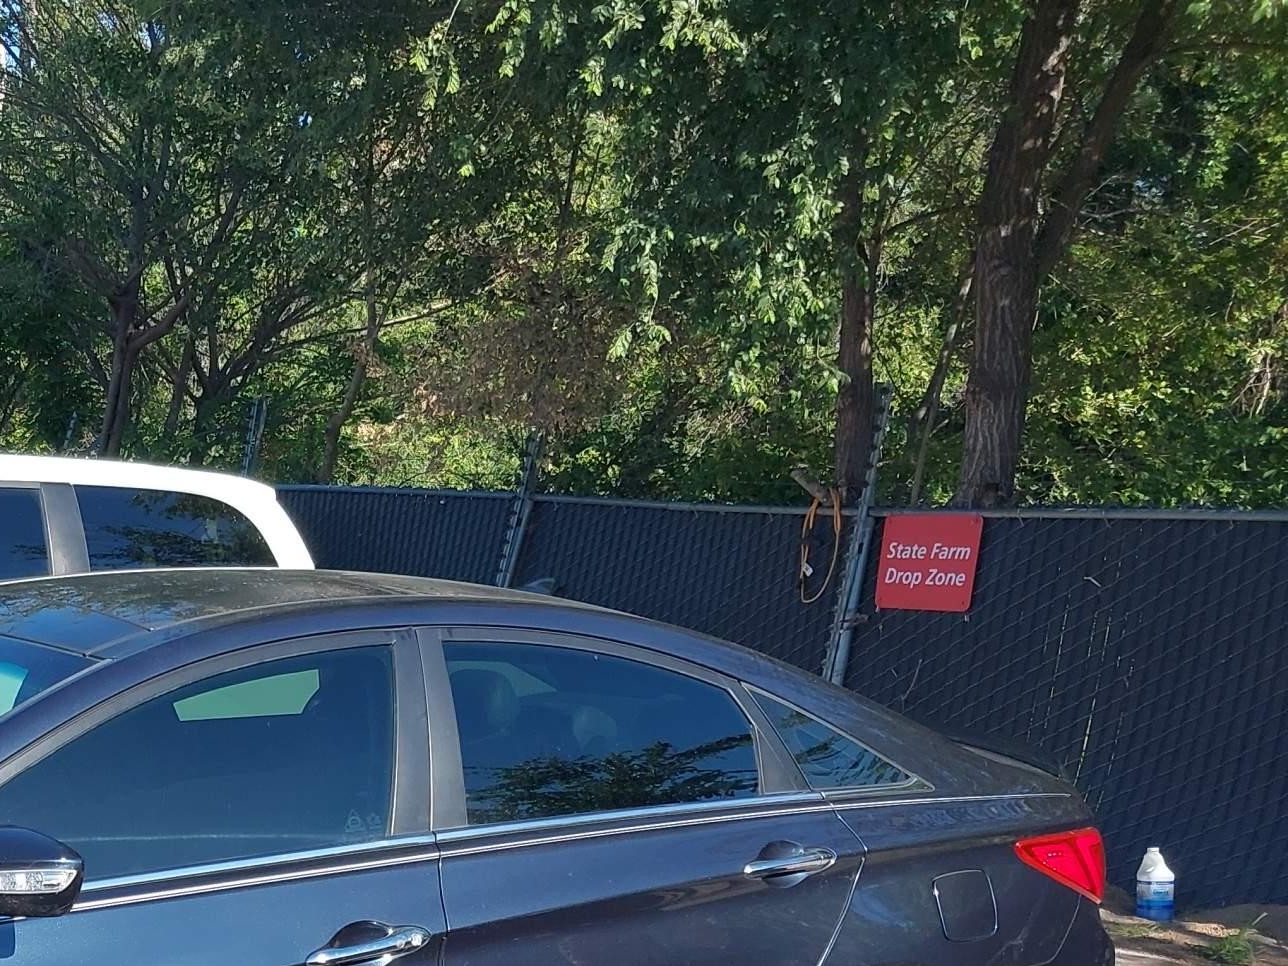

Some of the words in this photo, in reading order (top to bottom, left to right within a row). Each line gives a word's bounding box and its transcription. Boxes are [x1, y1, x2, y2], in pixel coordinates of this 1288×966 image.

[887, 542, 926, 559] State
[931, 543, 971, 560] Farm
[885, 567, 922, 588] Drop
[925, 568, 966, 586] Zone
